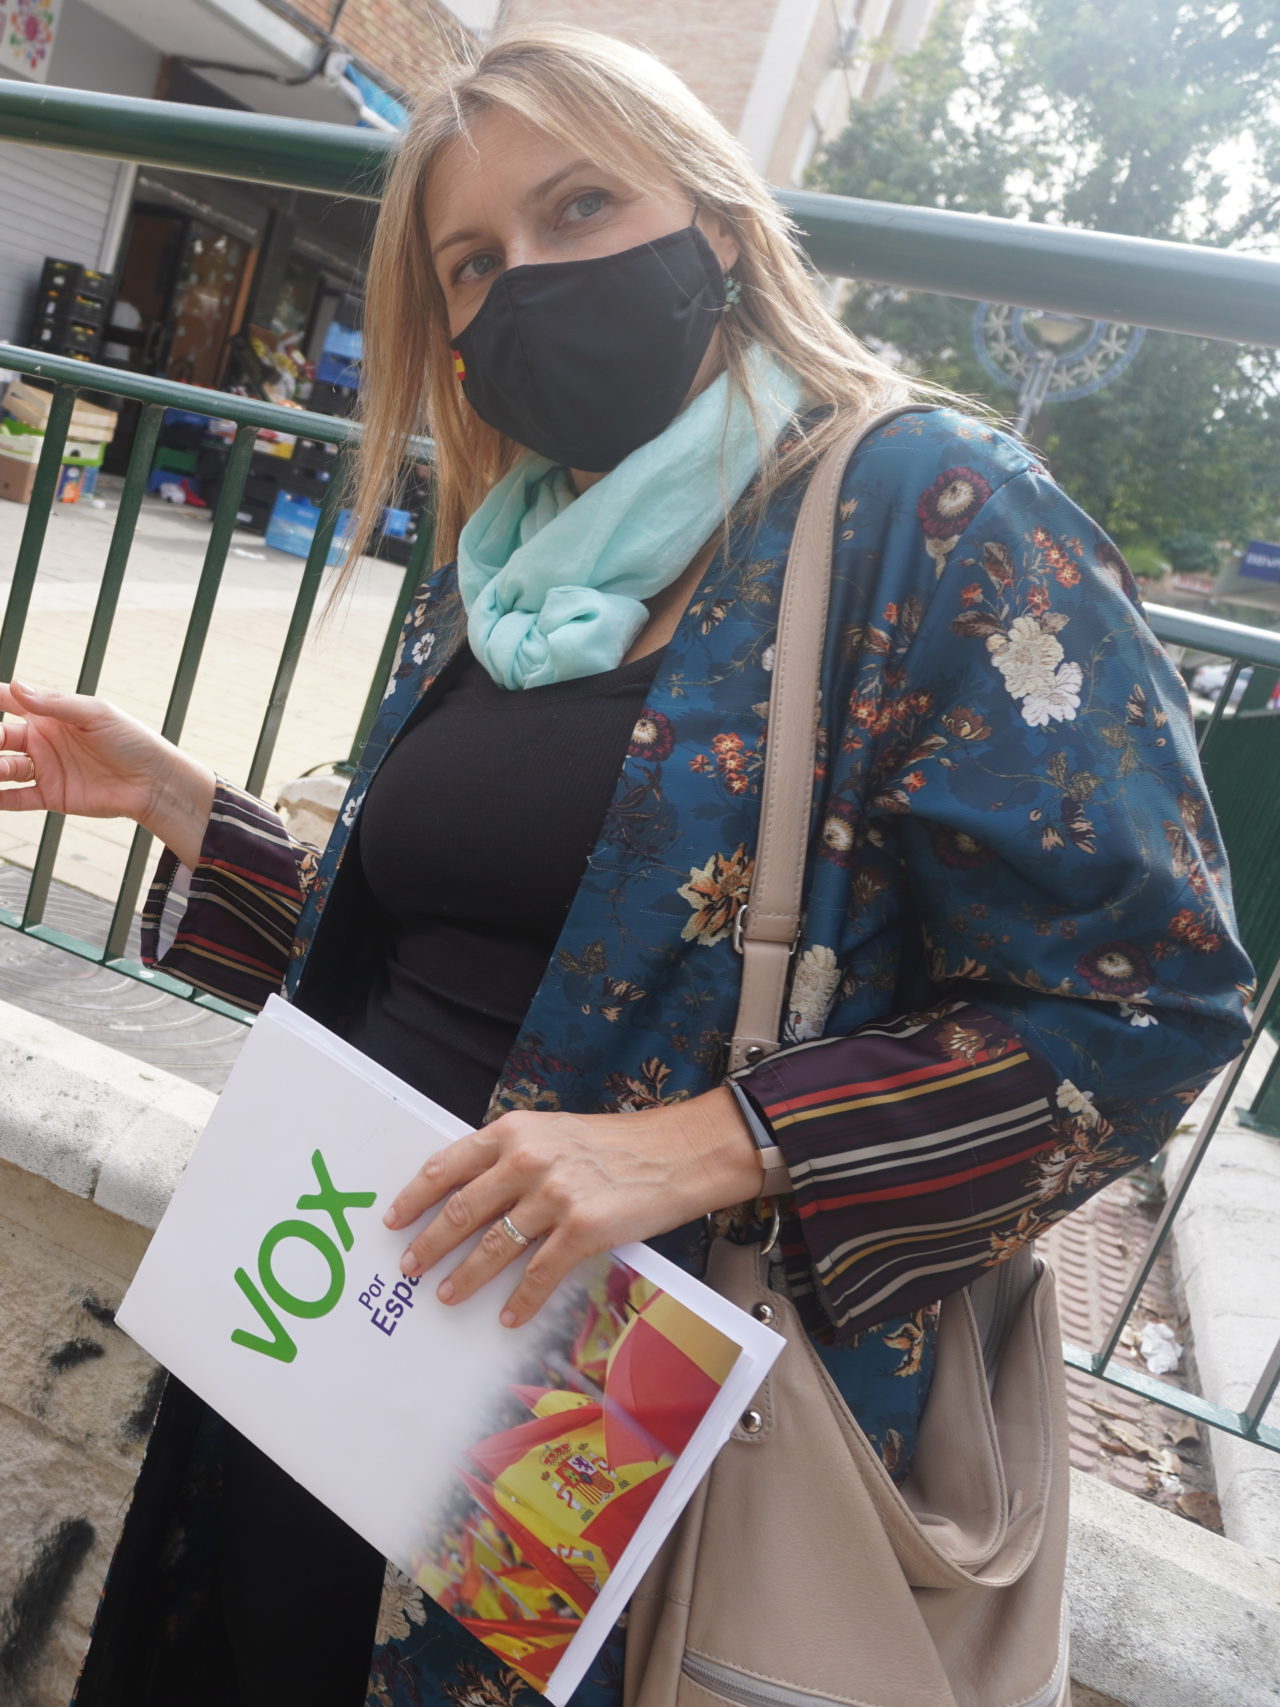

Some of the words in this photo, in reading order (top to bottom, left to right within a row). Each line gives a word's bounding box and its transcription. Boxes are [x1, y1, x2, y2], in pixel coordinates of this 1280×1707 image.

[230, 1148, 377, 1364] VOX
[358, 1273, 387, 1311] Por
[370, 1271, 423, 1336] Espa
